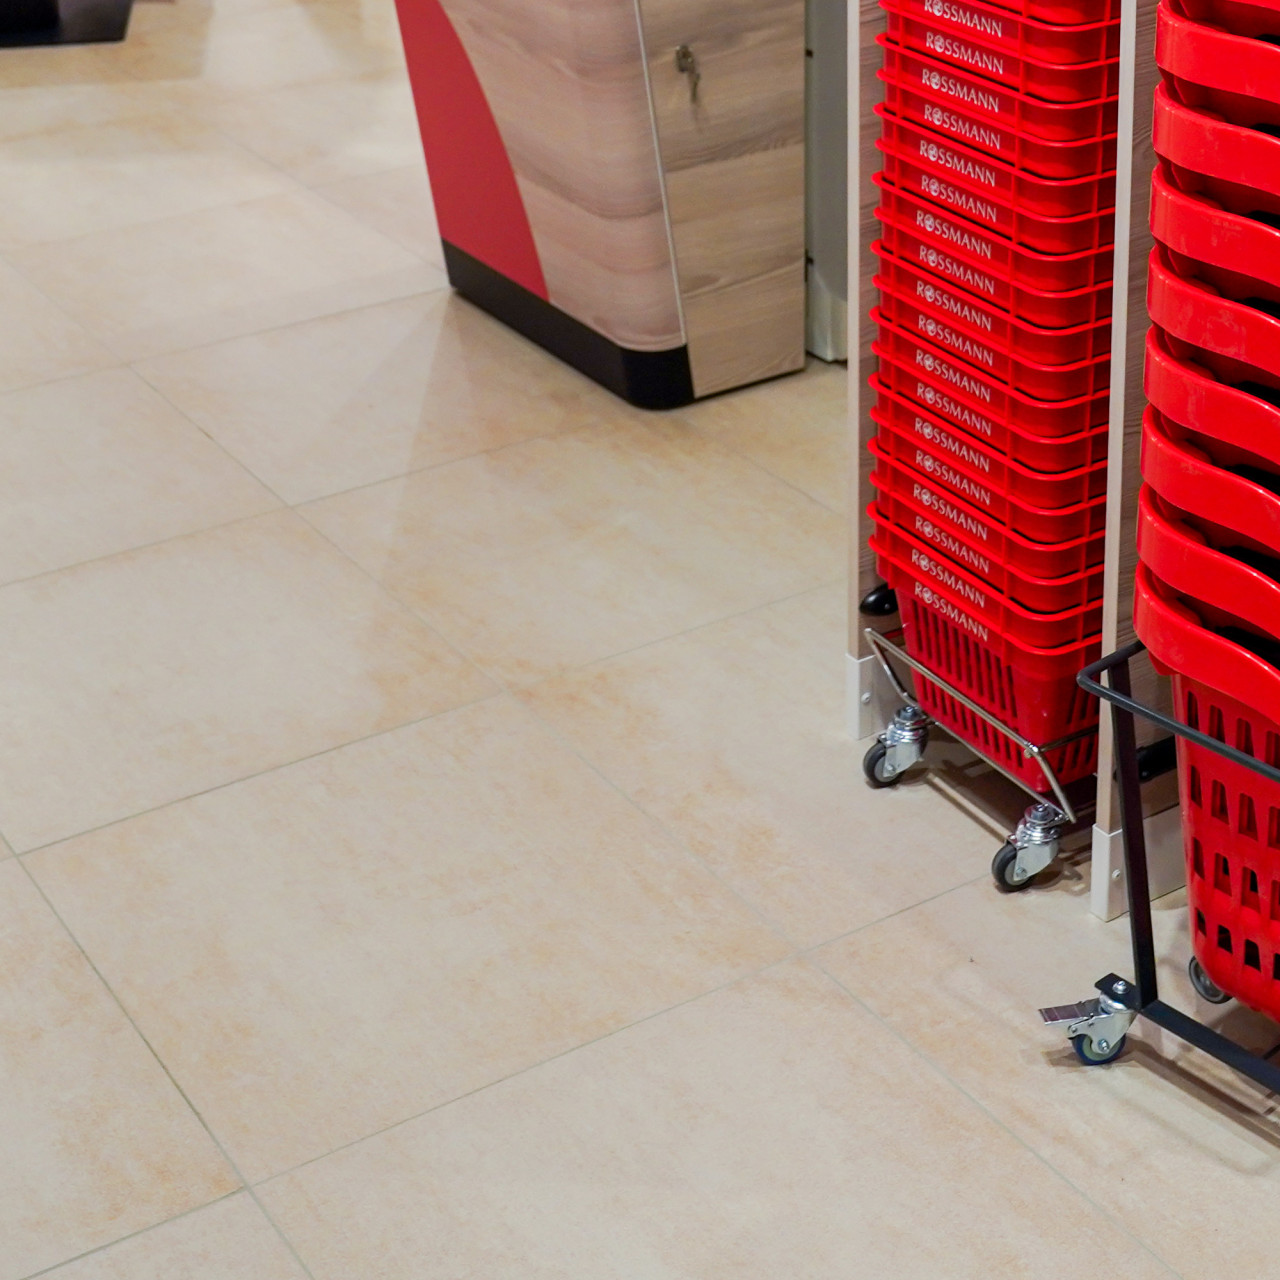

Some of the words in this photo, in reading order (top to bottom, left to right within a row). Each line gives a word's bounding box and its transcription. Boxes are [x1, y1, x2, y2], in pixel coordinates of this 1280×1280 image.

[925, 31, 1003, 75] ROSSMANN
[921, 67, 999, 113] ROSSMANN
[924, 103, 1000, 150] ROSSMANN
[919, 139, 995, 187] ROSSMANN
[921, 174, 996, 223] ROSSMANN
[916, 209, 991, 259] ROSSMANN
[919, 244, 994, 294] ROSSMANN
[916, 280, 991, 331] ROSSMANN
[918, 314, 993, 366] ROSSMANN
[915, 349, 990, 402] ROSSMANN
[917, 382, 991, 436] ROSSMANN
[914, 416, 989, 472] ROSSMANN
[915, 449, 990, 505] ROSSMANN
[913, 483, 987, 540] ROSSMANN
[915, 515, 989, 573] ROSSMANN
[911, 548, 985, 608] ROSSMANN
[914, 581, 988, 641] ROSSMANN
